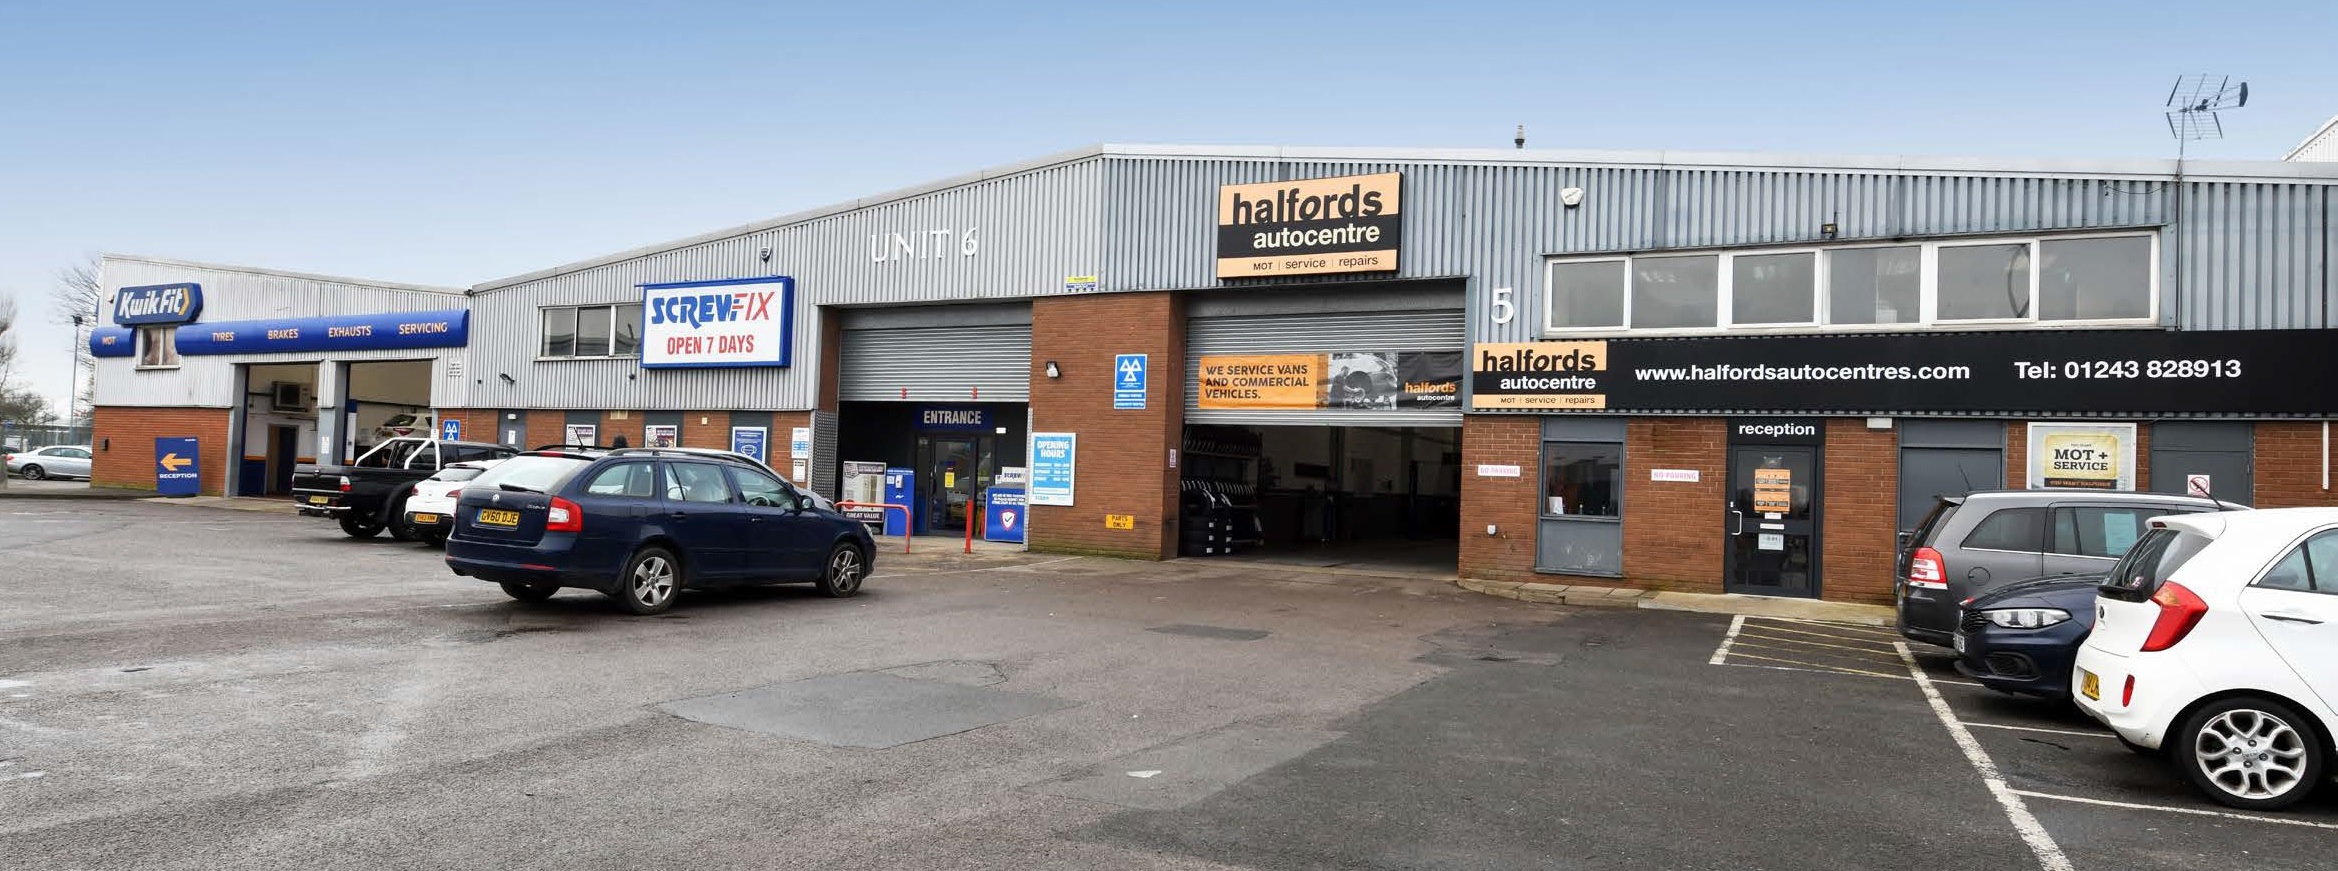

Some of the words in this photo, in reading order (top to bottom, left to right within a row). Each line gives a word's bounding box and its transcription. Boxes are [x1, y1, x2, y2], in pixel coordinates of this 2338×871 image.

[1232, 184, 1384, 226] halfords
[1252, 222, 1381, 250] autocentre
[870, 230, 950, 263] UNIT
[961, 227, 978, 257] 6
[1253, 262, 1273, 271] MOT
[1284, 257, 1326, 270] service
[1338, 255, 1379, 269] repairs
[651, 291, 776, 329] SCREWFIX
[1490, 287, 1515, 324] 5
[212, 332, 234, 342] TYRES
[267, 328, 299, 340] BRAKES
[328, 325, 372, 338] EXHAUSTS
[399, 322, 448, 335] SERVICING
[667, 337, 701, 356] OPEN
[706, 336, 713, 353] 7
[718, 334, 755, 353] DAYS
[1482, 349, 1596, 372] halfords
[1206, 366, 1224, 376] WE
[1227, 366, 1274, 375] SERVICE
[1278, 365, 1308, 375] VANS
[1635, 362, 1970, 382] www.halfordsautocentres.com
[2014, 360, 2057, 379] Tel:
[2064, 360, 2139, 379] 01243
[2146, 359, 2242, 378] 828913
[1205, 377, 1228, 387] AND
[1232, 377, 1309, 388] COMMERCIAL
[1405, 382, 1456, 394] halfords
[1500, 376, 1596, 390] autocentre
[1205, 389, 1261, 399] VEHICLES.
[1525, 396, 1557, 404] service
[1565, 396, 1596, 406] repairs
[923, 410, 982, 425] ENTRANCE
[1738, 422, 1816, 438] reception
[1037, 440, 1069, 450] OPENING
[1040, 450, 1066, 458] HOURS
[2054, 449, 2094, 460] MOT
[2053, 461, 2109, 471] SERVICE
